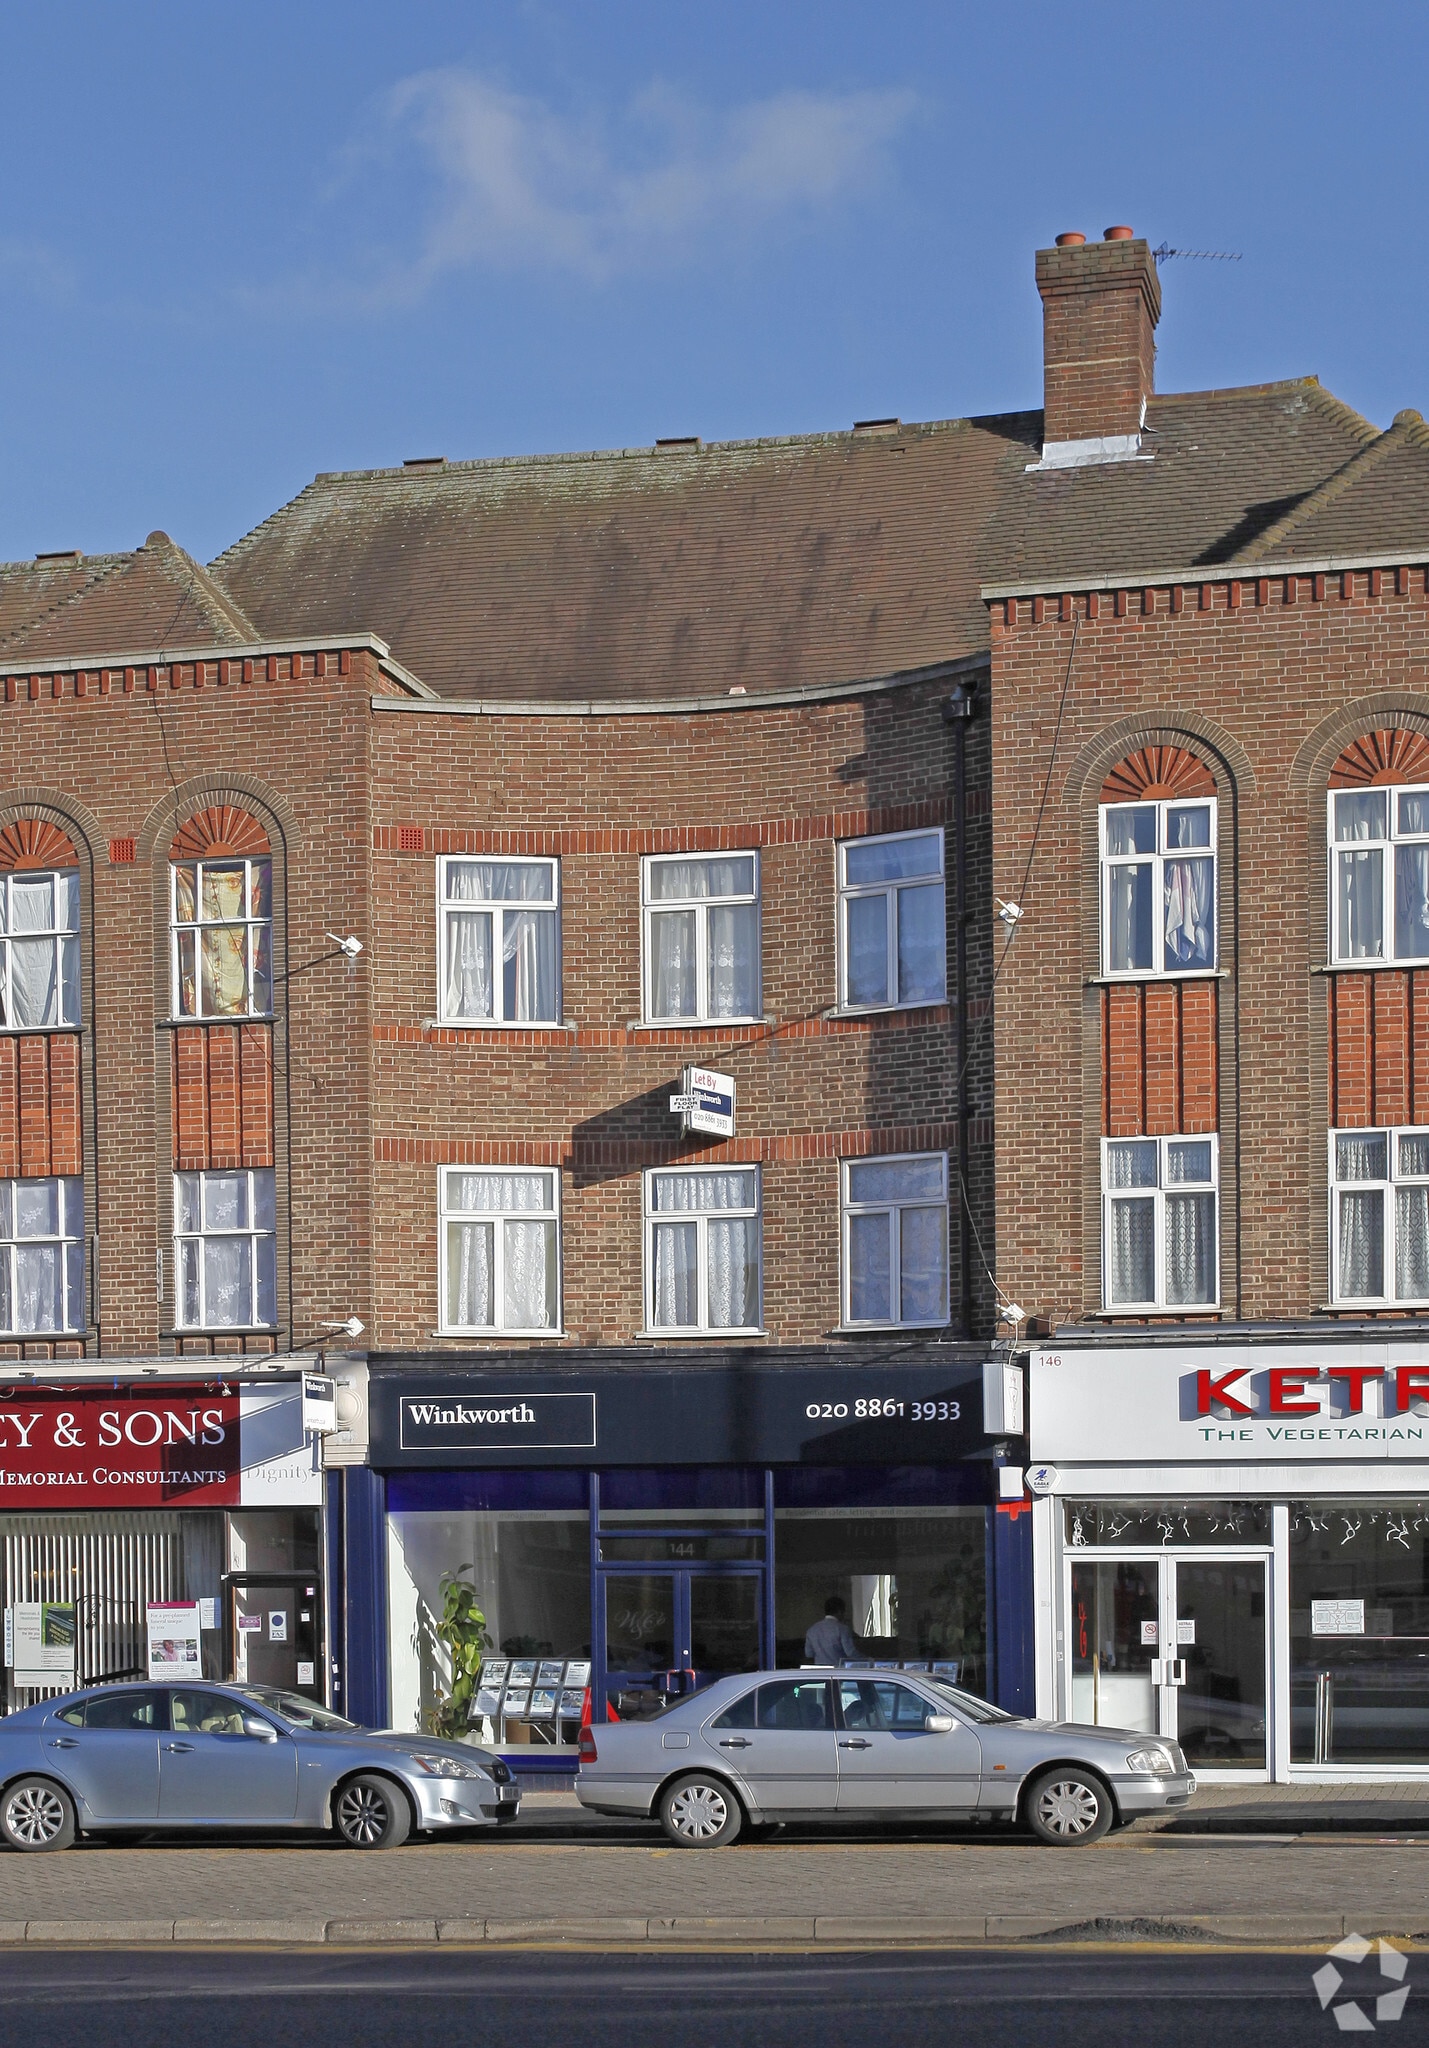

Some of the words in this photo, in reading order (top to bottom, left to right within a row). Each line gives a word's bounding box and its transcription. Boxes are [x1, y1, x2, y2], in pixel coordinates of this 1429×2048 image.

[695, 1072, 706, 1085] Let
[707, 1075, 717, 1090] By
[1039, 1356, 1062, 1367] 146
[1197, 1366, 1429, 1415] KETR
[408, 1403, 536, 1425] Winkworth
[805, 1403, 849, 1418] 020
[854, 1399, 904, 1418] 8861
[911, 1402, 961, 1421] 3933
[53, 1412, 86, 1447] &
[98, 1410, 226, 1447] SONS
[1198, 1428, 1253, 1441] THE
[1266, 1427, 1423, 1441] VEGETARIAN
[93, 1467, 227, 1485] CONSULTANTS
[247, 1464, 308, 1483] Dignity
[670, 1543, 694, 1556] 144
